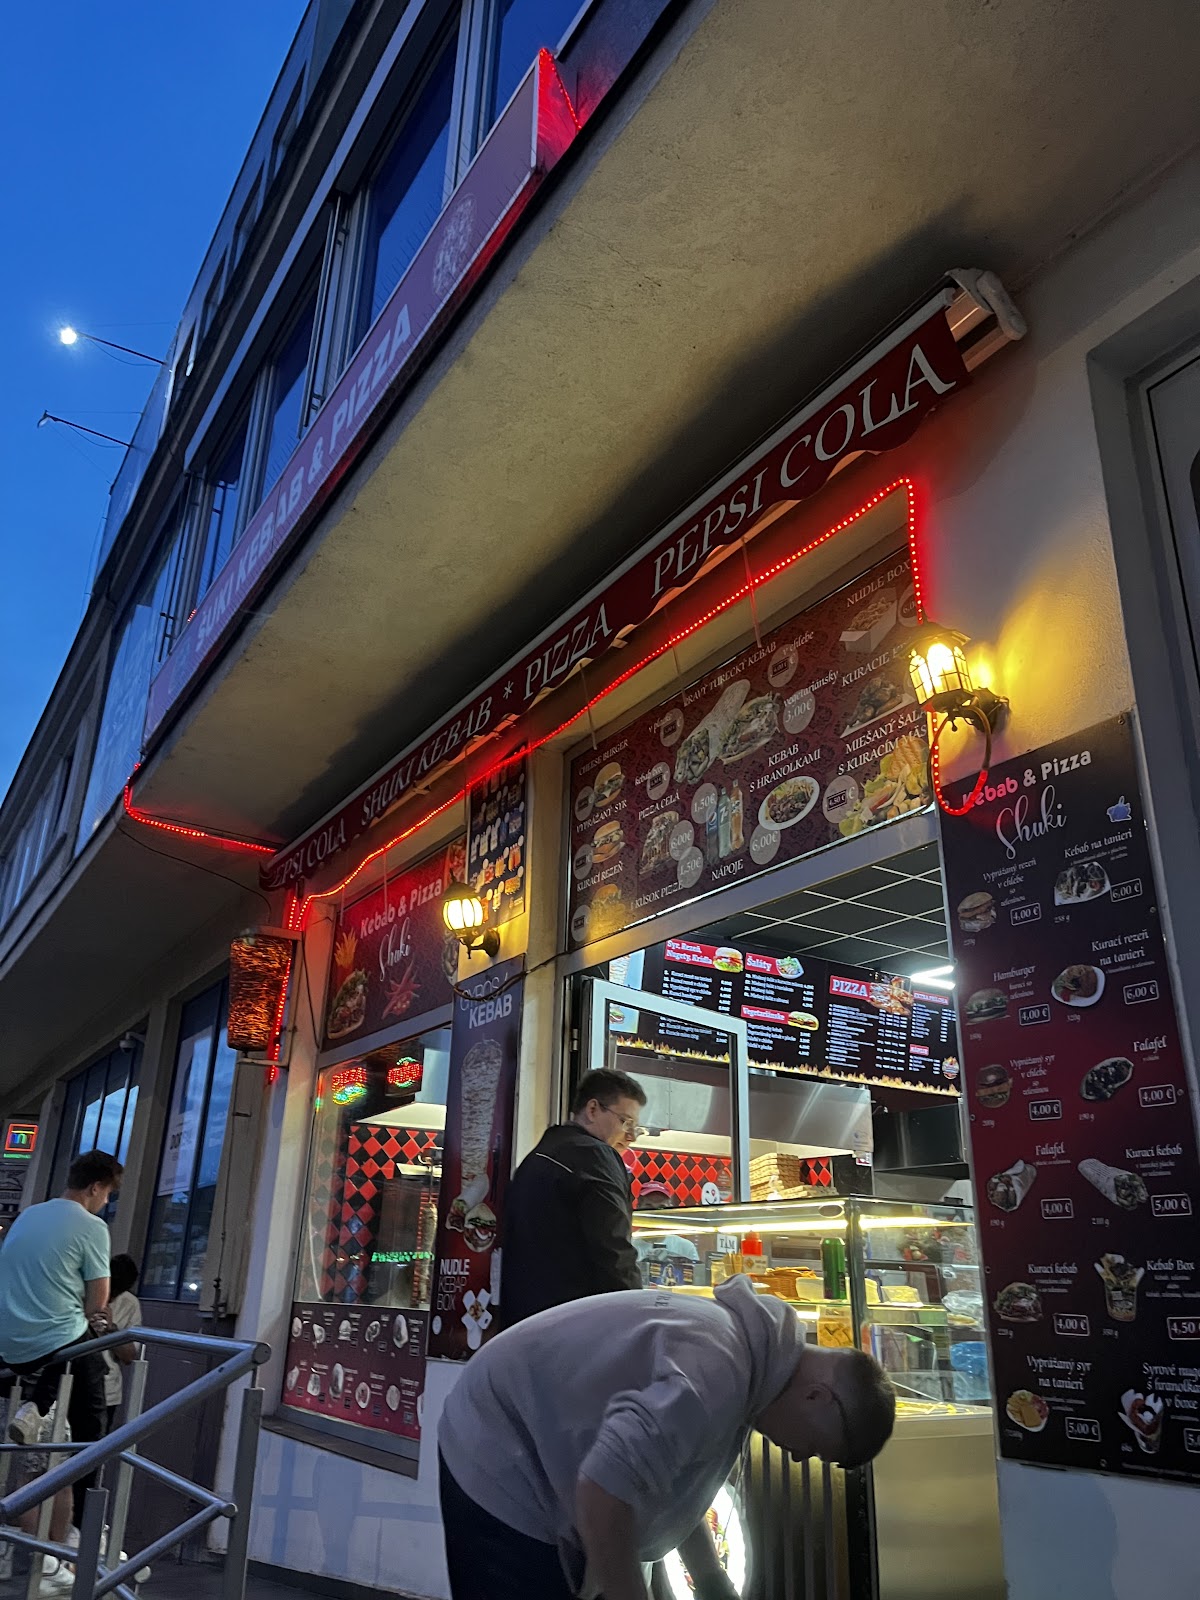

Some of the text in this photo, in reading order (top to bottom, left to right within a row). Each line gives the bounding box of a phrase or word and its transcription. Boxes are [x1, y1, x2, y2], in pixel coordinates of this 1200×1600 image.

[234, 477, 303, 589] KEBAB
[307, 436, 323, 483] &
[329, 304, 410, 454] PIZZA
[846, 576, 885, 608] NUDLE
[887, 558, 911, 583] BOX
[268, 343, 957, 888] EPSI COLA SHUKI KEBAB PIZZA PEPSI COLA
[748, 641, 776, 667] KEBAB
[841, 652, 890, 688] KURACIE
[784, 669, 839, 707] vegetariánsky
[845, 716, 896, 755] MIEŠANÝ
[579, 738, 629, 776] CHEESE BURGER
[768, 743, 799, 767] KEBAB
[837, 764, 844, 776] S
[846, 736, 900, 771] KURACÍM
[749, 748, 821, 792] S HRANOLKAMI
[1022, 768, 1037, 788] &
[1041, 750, 1092, 781] Pizza
[614, 799, 628, 815] SYR
[638, 789, 680, 821] PIZZA CELÁ
[996, 784, 1067, 860] Shuki
[1063, 840, 1090, 859] Kebab
[1091, 840, 1102, 850] na
[1103, 829, 1133, 846] tanieri
[711, 859, 744, 881] NÁPOJE
[1018, 857, 1037, 870] rezeň
[1003, 874, 1025, 888] chlebe
[1112, 881, 1141, 899] 6,00 €
[360, 878, 443, 940] Kebab & Pizza
[1012, 905, 1040, 922] 4,00 €
[378, 916, 412, 982] Shuki
[1091, 928, 1149, 952] Kurací rezeň
[746, 955, 772, 971] Šaláty
[1100, 946, 1146, 966] na tanieri
[993, 966, 1036, 982] Hamburger
[831, 979, 868, 998] PIZZA
[1126, 983, 1156, 999] 6,00 €
[468, 993, 514, 1030] KEBAB
[1021, 1007, 1048, 1023] 4,00 €
[1133, 1035, 1167, 1054] Falafel
[1142, 1087, 1173, 1102] 4,00 €
[1031, 1102, 1059, 1116] 4,00 €
[1035, 1141, 1065, 1159] Falafel
[1156, 1142, 1183, 1156] kebab
[1043, 1201, 1071, 1214] 4,00 €
[1154, 1198, 1188, 1211] 5,00 €
[439, 1258, 471, 1276] NUDLE
[1054, 1262, 1078, 1274] kebab
[1146, 1258, 1195, 1272] Kebab Box
[436, 1293, 456, 1311] BOX
[1056, 1318, 1087, 1331] 4,00 €
[1170, 1321, 1196, 1334] 4,50
[1076, 1361, 1092, 1376] syr
[1142, 1361, 1177, 1377] Syrové
[1038, 1376, 1085, 1390] na tanieri
[1164, 1397, 1173, 1407] v
[1067, 1423, 1099, 1436] 5,00 €
